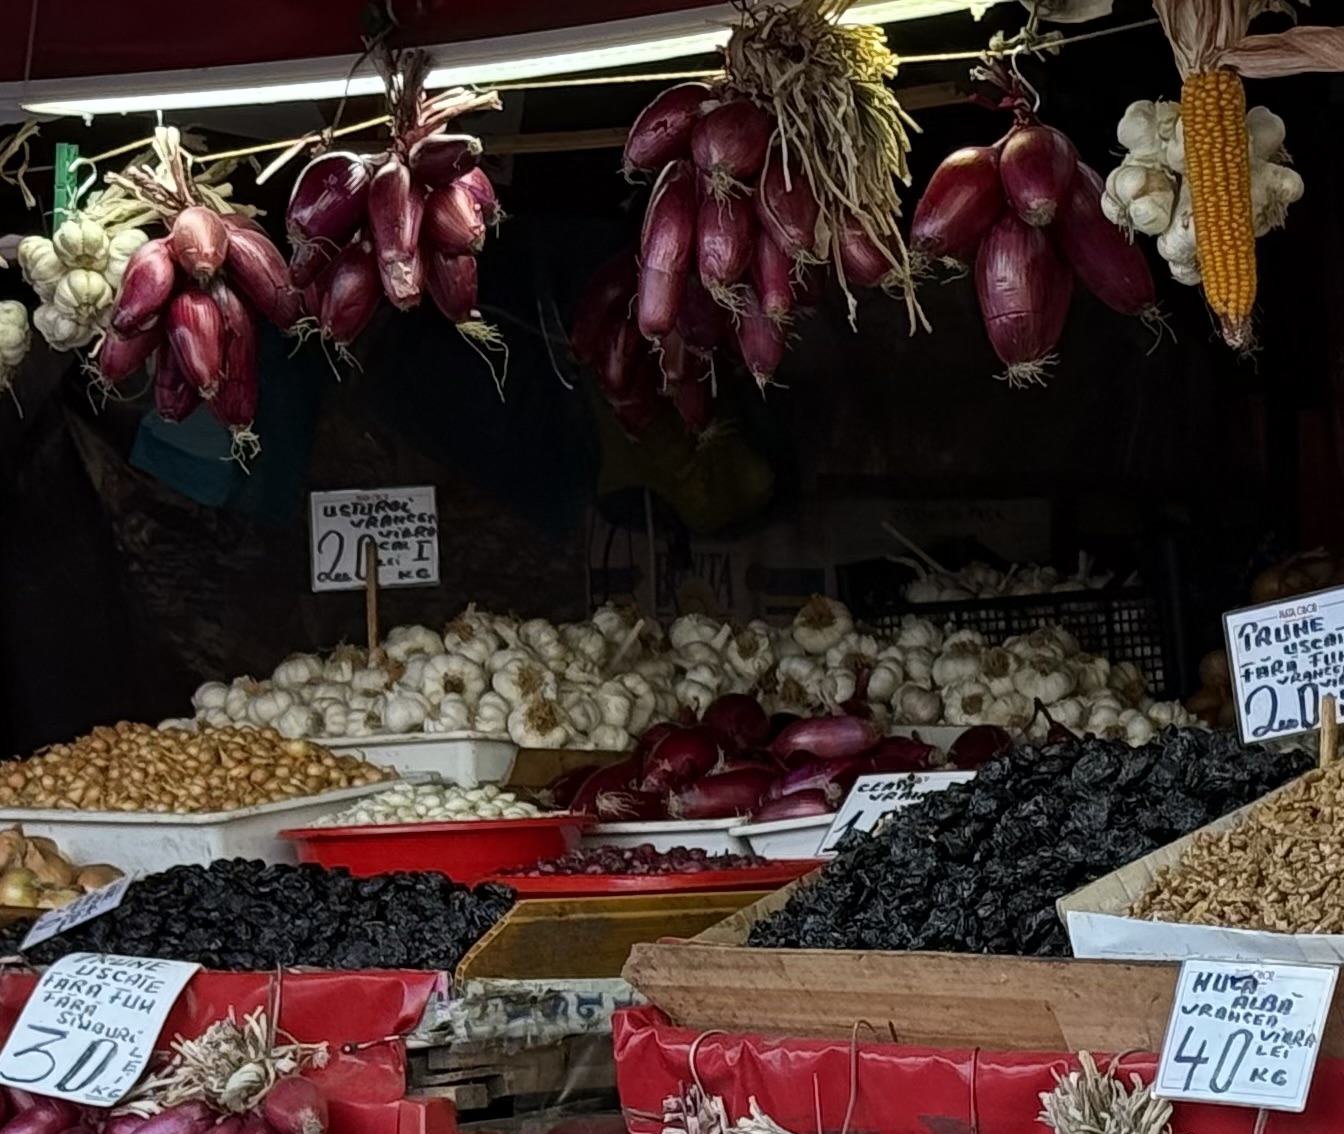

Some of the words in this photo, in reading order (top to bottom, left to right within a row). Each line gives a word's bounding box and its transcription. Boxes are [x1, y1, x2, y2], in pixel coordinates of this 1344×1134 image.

[0, 1024, 118, 1092] 30
[1173, 1026, 1254, 1094] 40
[1249, 1067, 1288, 1087] KG
